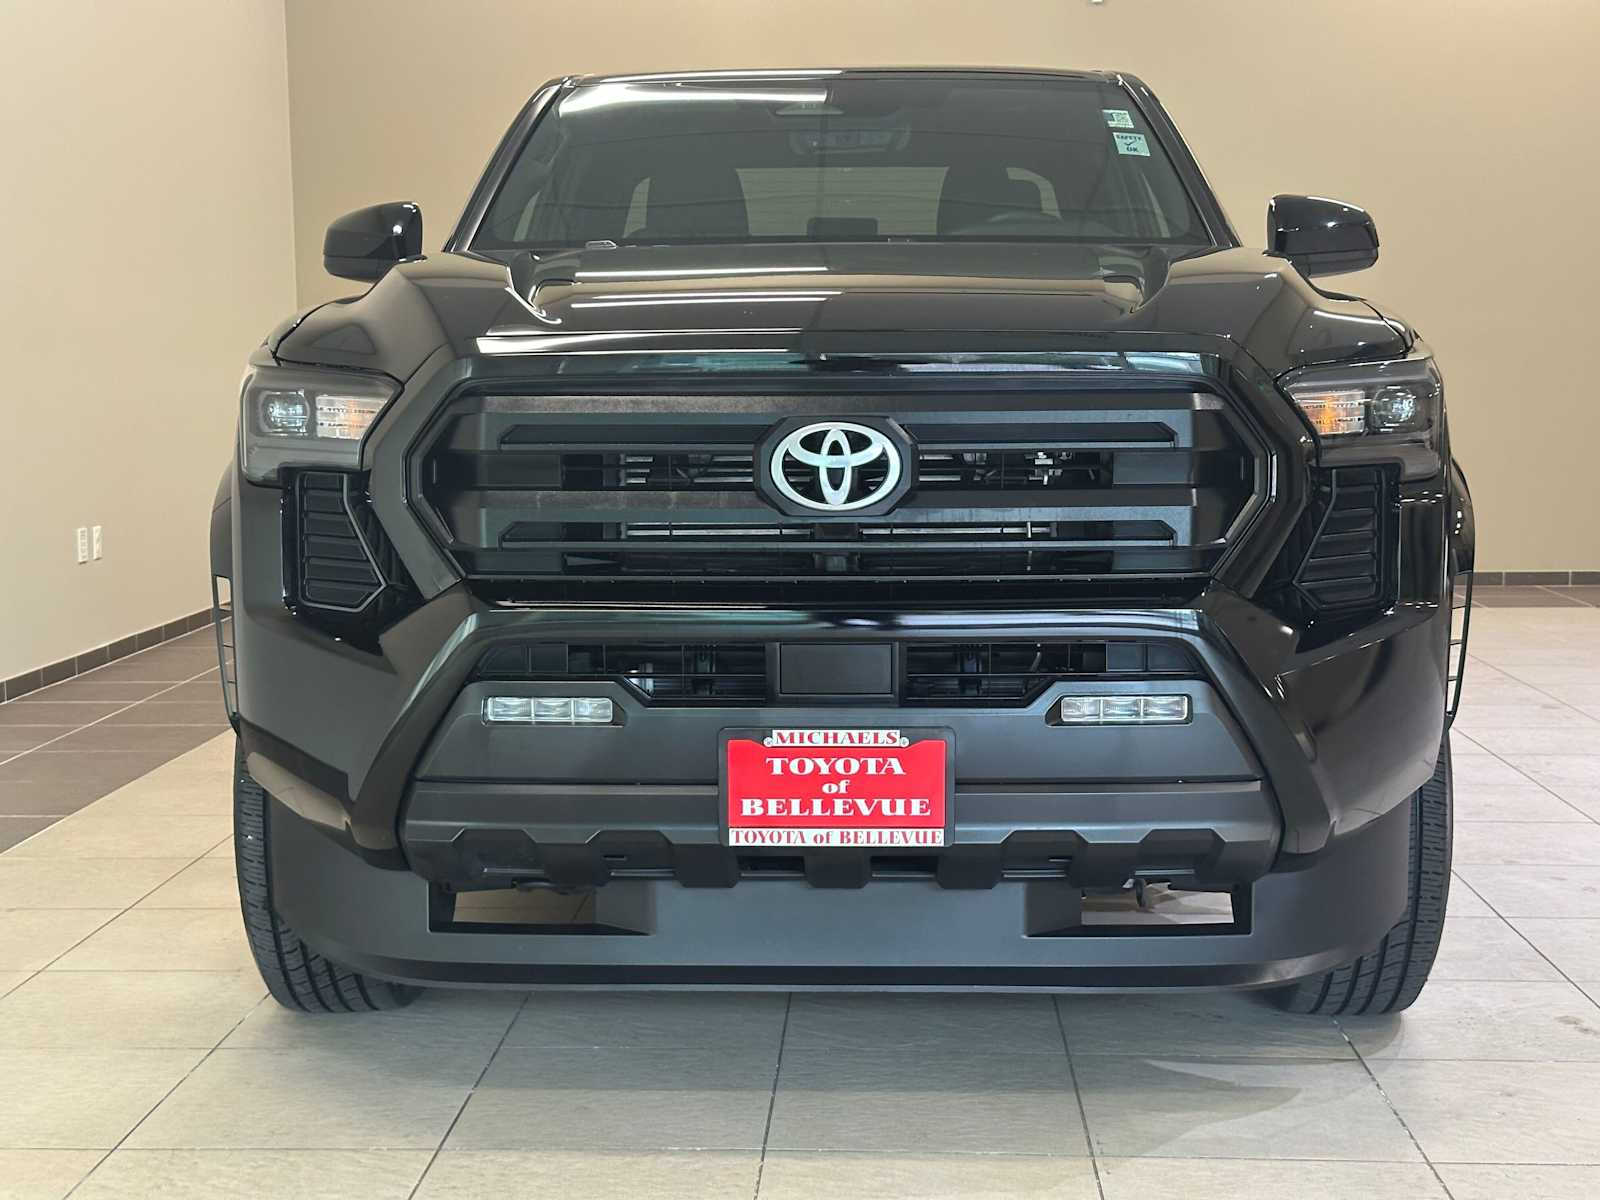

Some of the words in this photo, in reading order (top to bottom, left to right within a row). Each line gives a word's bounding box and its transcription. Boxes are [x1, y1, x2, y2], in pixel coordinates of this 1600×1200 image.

[775, 731, 898, 744] MICHAELS
[766, 757, 906, 775] TOYOTA
[821, 780, 851, 794] of
[740, 798, 931, 816] BELLEVUE
[731, 830, 807, 844] TOYOTA
[813, 830, 833, 844] of
[839, 830, 943, 844] BELLEVUE
